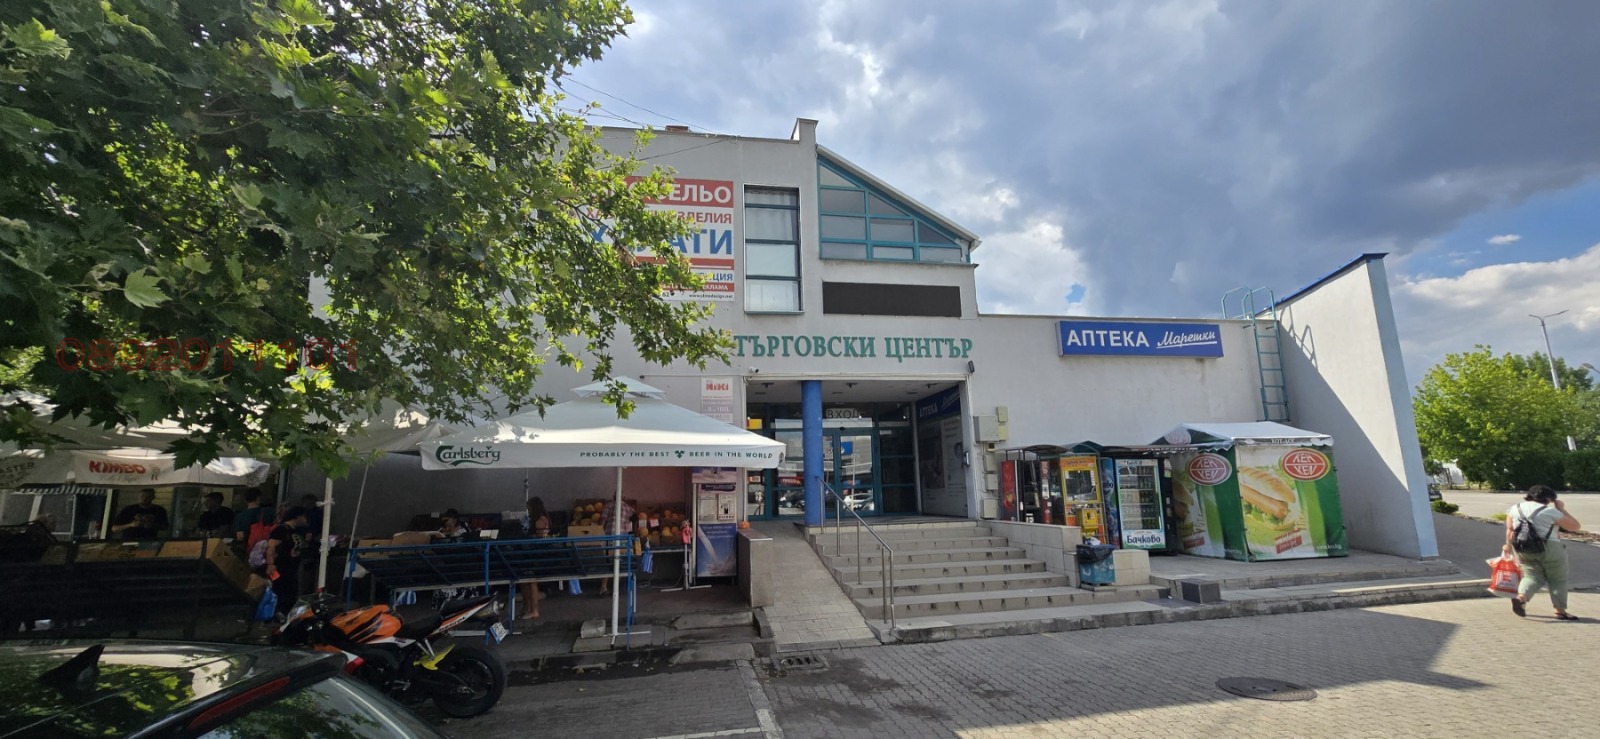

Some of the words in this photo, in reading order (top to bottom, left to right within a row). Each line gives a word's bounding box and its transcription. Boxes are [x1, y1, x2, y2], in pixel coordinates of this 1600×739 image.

[1066, 329, 1150, 348] АПТЕКА
[1156, 331, 1217, 348] Марешки
[734, 335, 876, 358] ТЪРГОВСКИ
[884, 337, 973, 362] ЦЕНТЪР
[435, 445, 501, 466] Carlsberg
[745, 452, 773, 460] WORLD
[89, 460, 146, 474] KIMBO
[1126, 534, 1161, 544] Бачково
